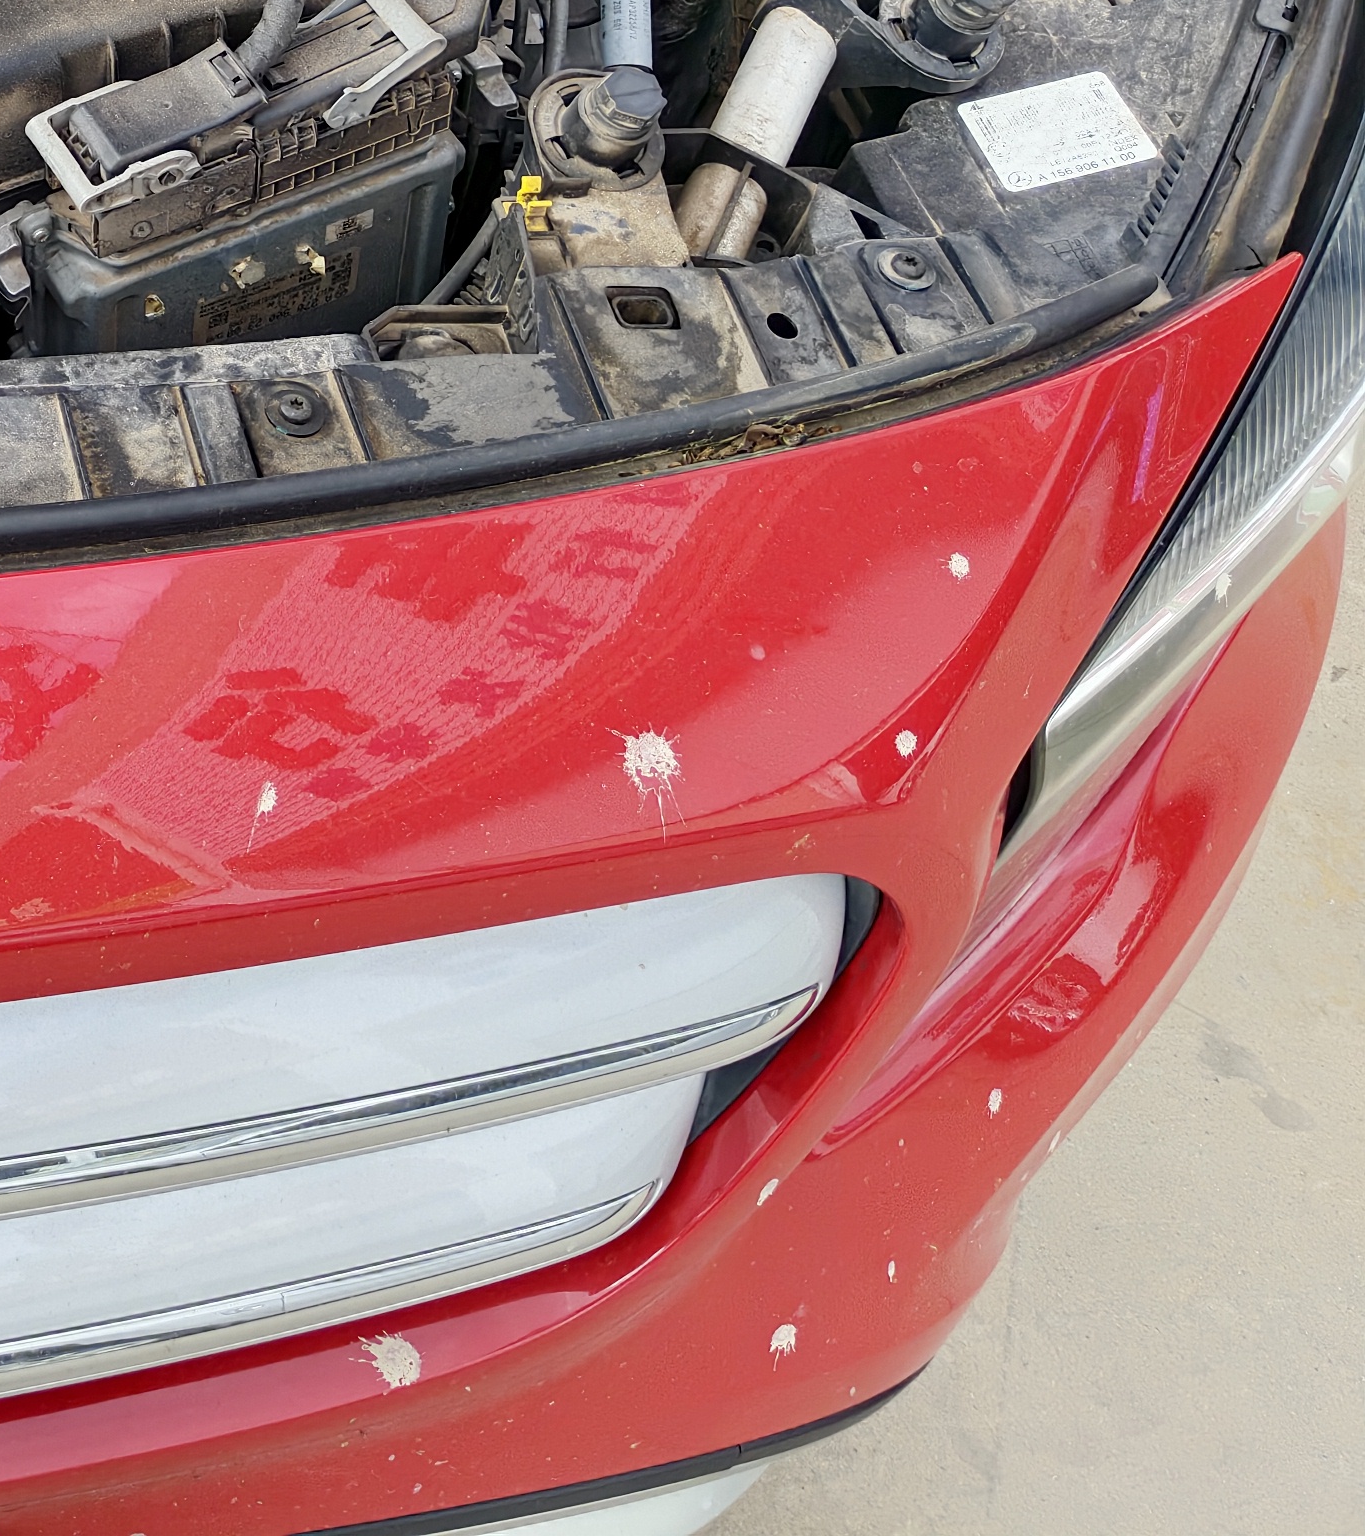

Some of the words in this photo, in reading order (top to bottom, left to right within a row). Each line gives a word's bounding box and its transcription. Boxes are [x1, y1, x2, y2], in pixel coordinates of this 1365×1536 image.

[1050, 167, 1074, 179] 156
[1075, 161, 1099, 173] 906
[1101, 156, 1117, 167] 11
[1119, 151, 1136, 162] 00
